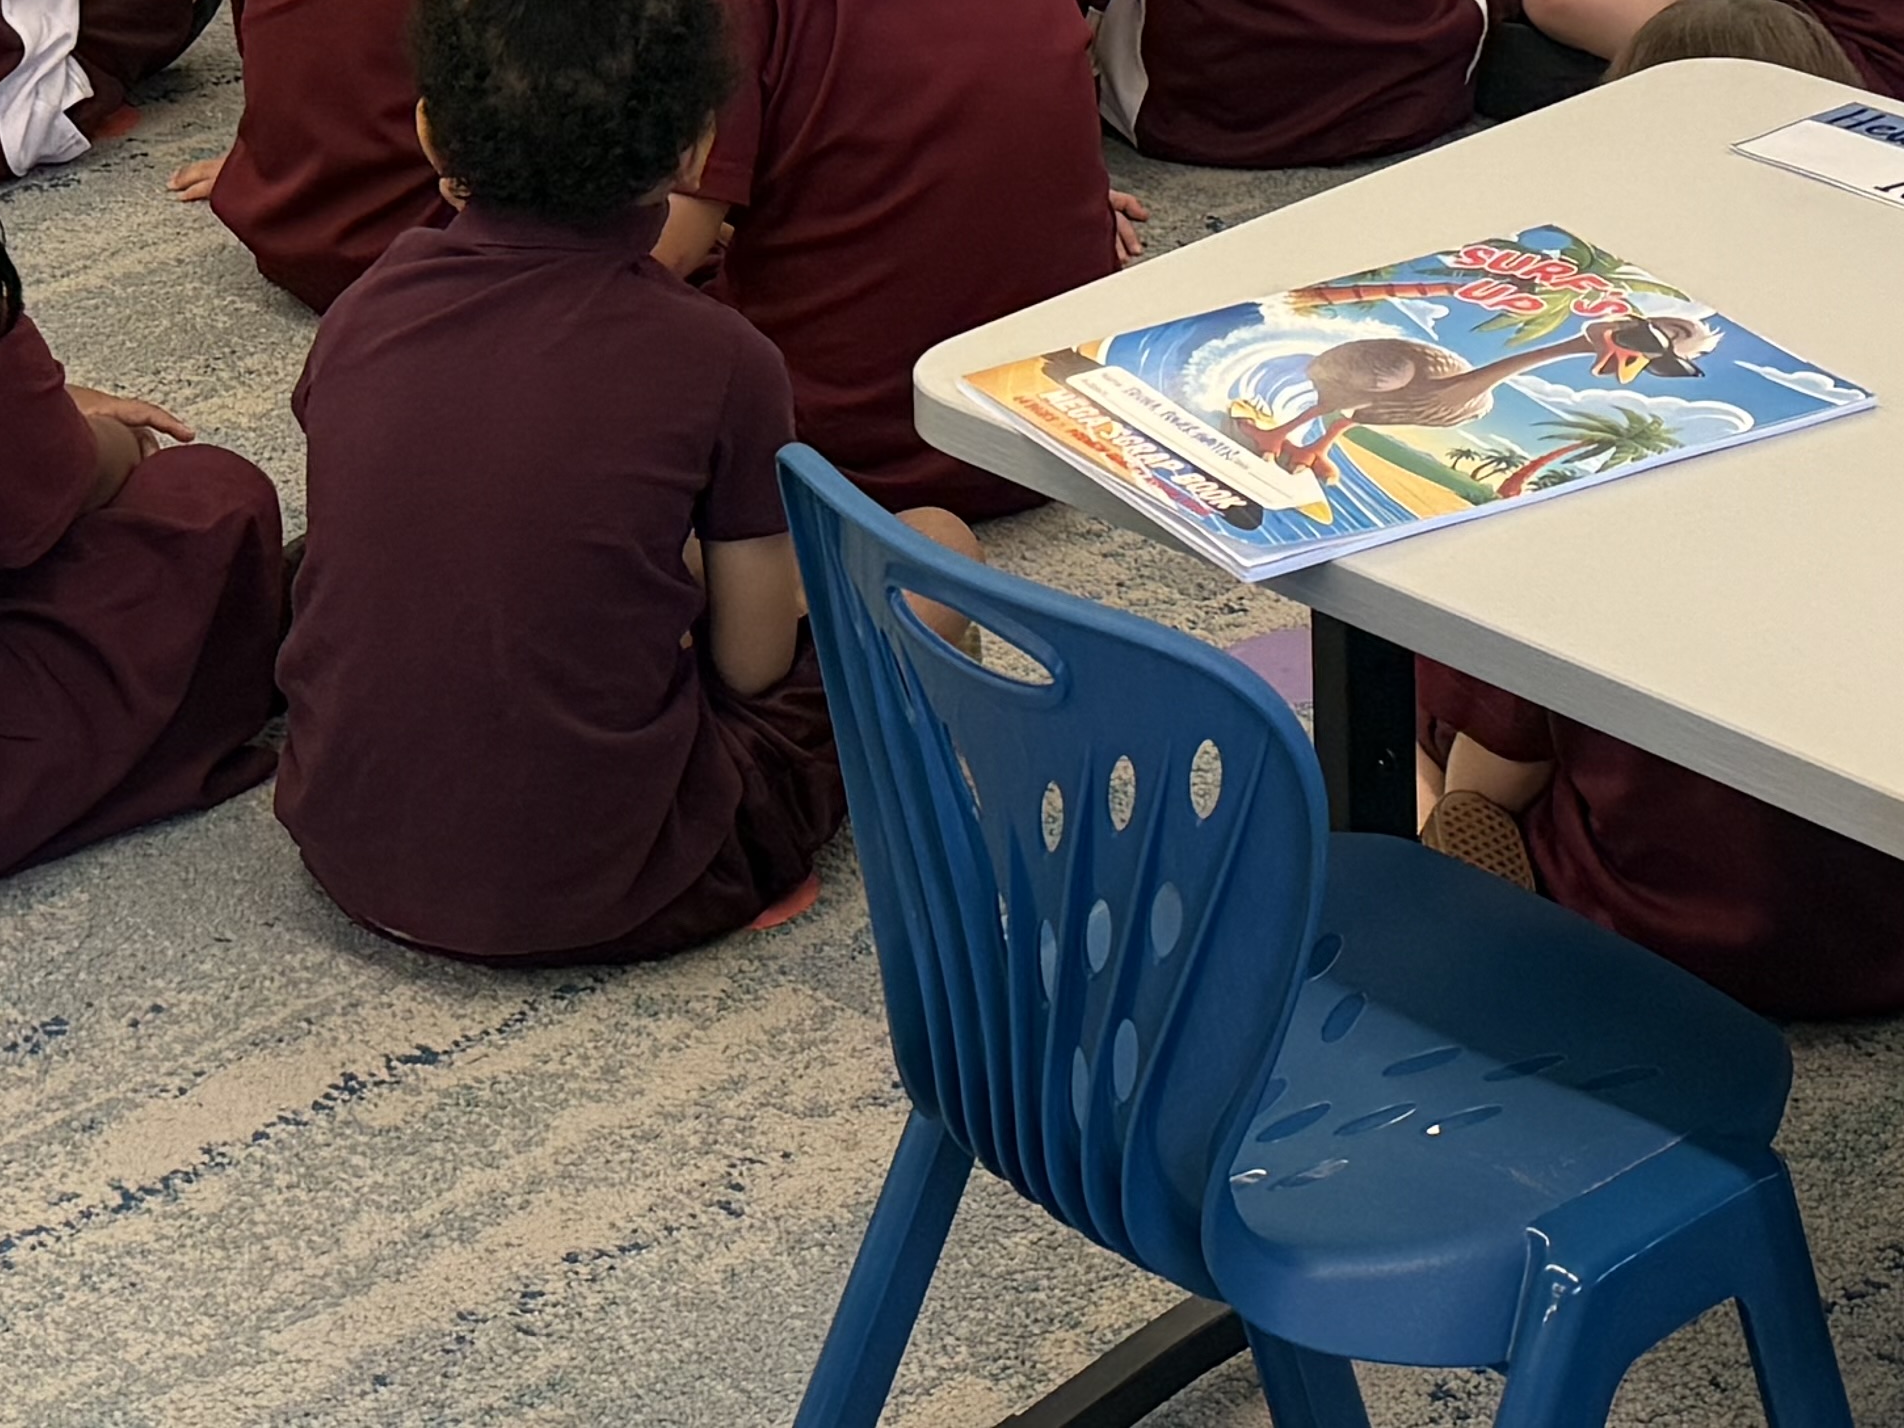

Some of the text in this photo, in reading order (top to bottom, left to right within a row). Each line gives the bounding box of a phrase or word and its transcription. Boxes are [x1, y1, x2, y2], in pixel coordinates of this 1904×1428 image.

[1453, 276, 1548, 317] UP
[1459, 244, 1633, 318] SURF'S
[1179, 472, 1248, 512] BOOK
